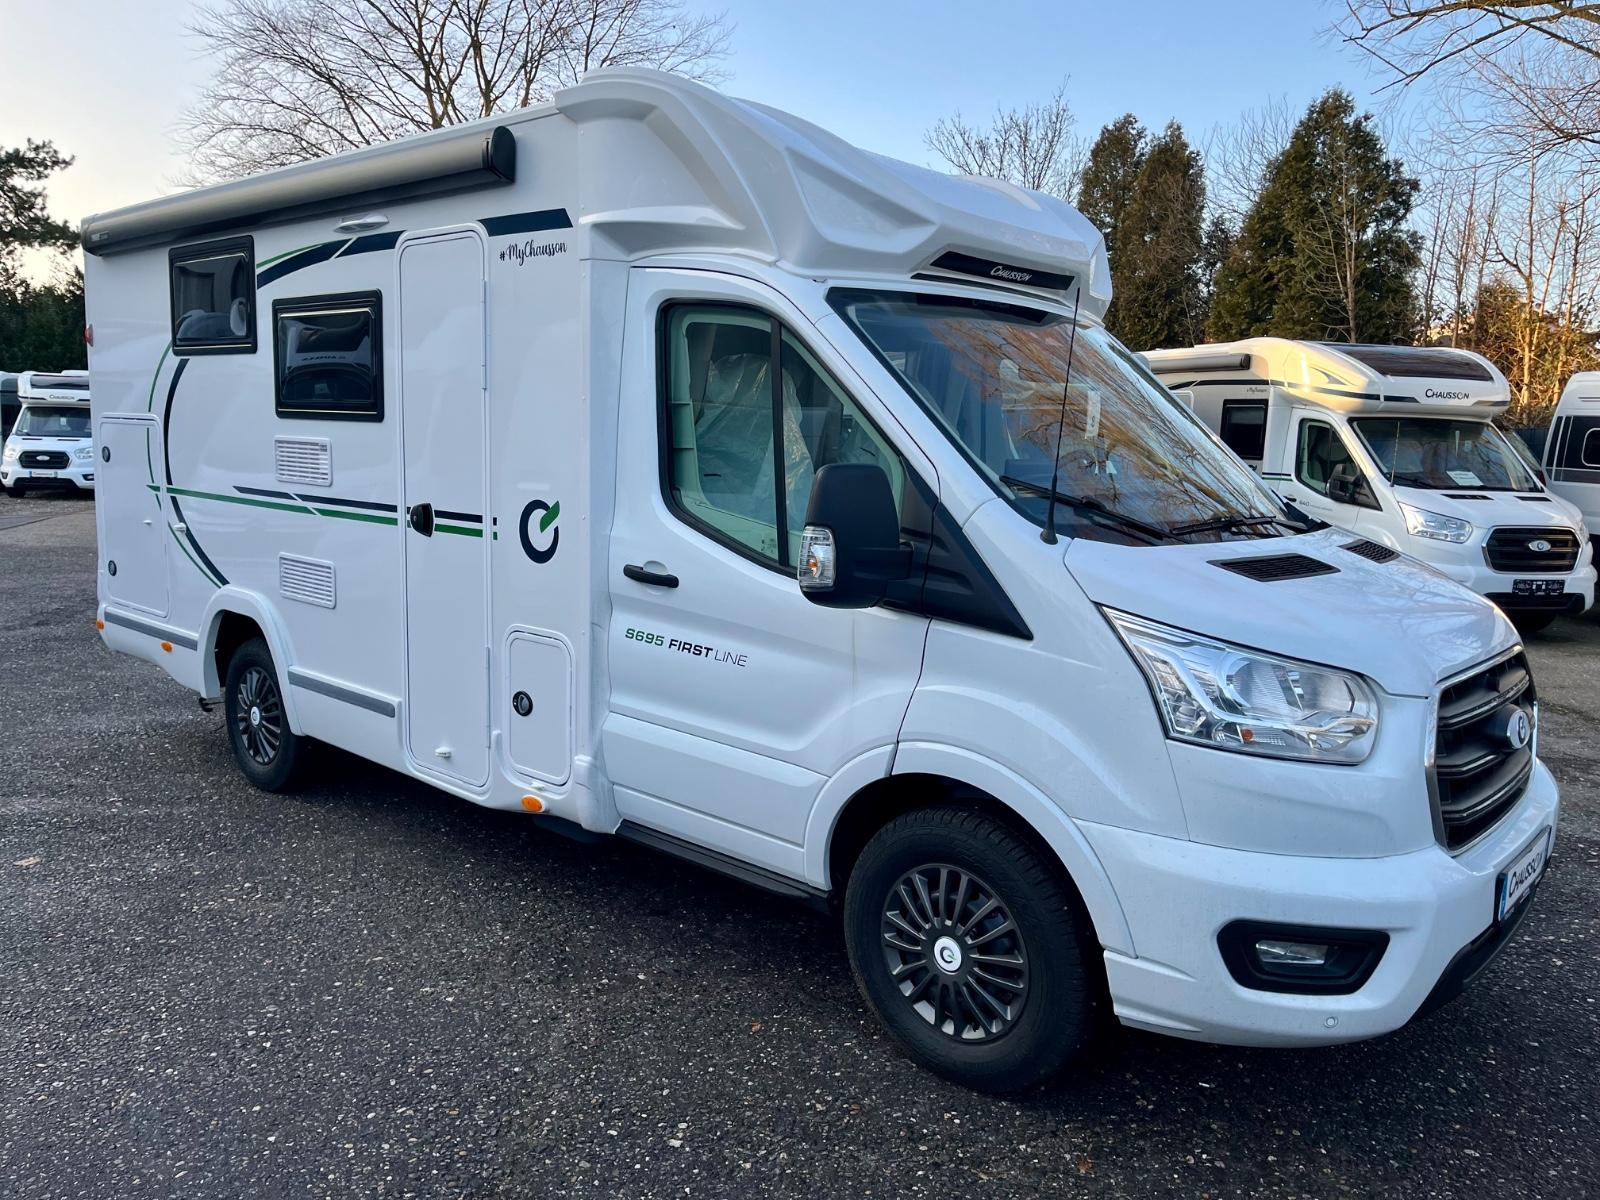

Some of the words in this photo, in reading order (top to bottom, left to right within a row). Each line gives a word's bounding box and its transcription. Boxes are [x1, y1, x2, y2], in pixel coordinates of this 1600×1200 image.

[499, 239, 567, 266] #MyChausson
[990, 265, 1033, 281] CHAUSSON
[1425, 388, 1470, 400] CHAUSSON
[624, 627, 665, 647] S695
[668, 638, 713, 658] FIRST
[714, 649, 748, 667] LINE
